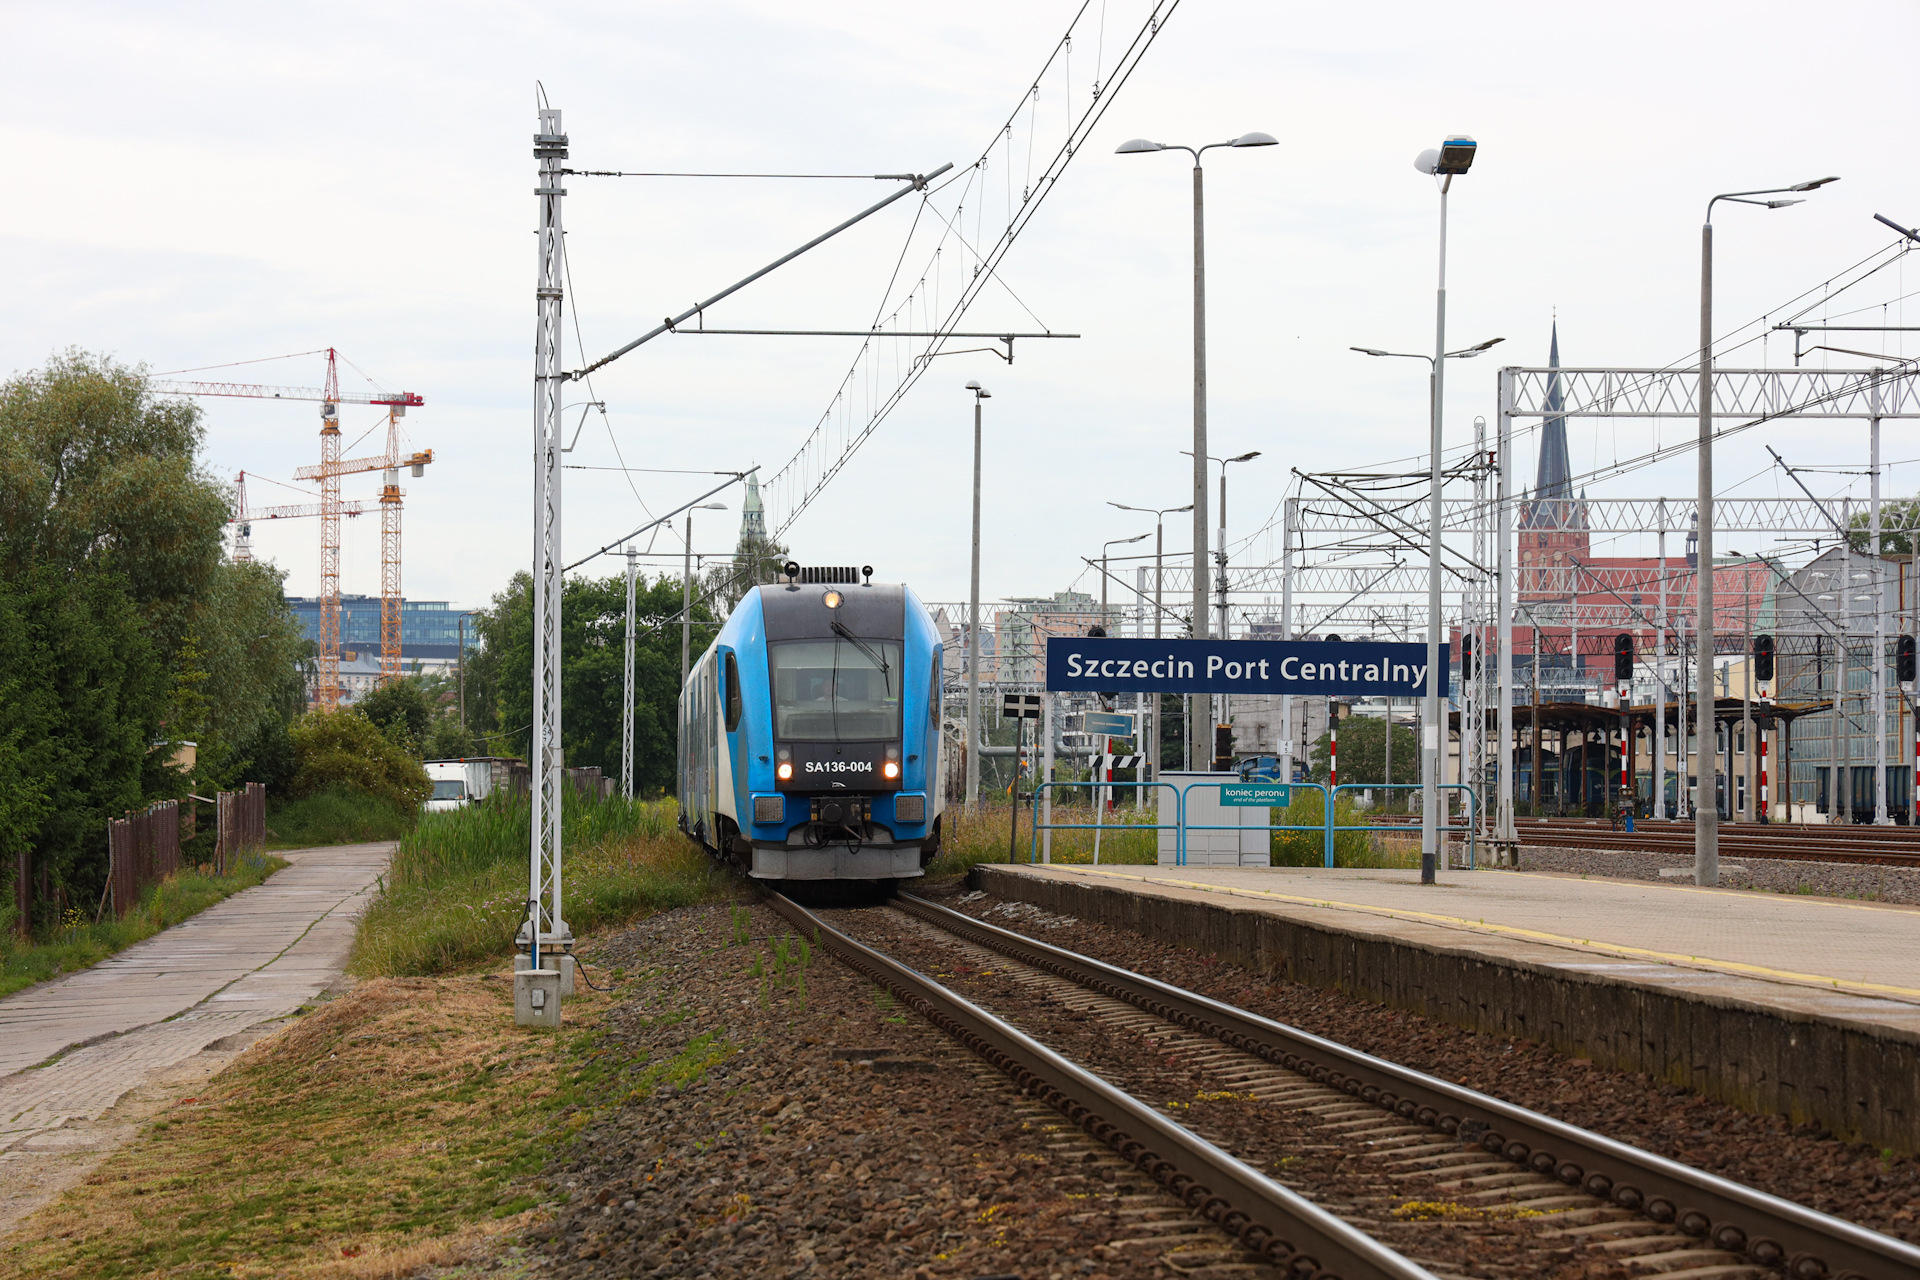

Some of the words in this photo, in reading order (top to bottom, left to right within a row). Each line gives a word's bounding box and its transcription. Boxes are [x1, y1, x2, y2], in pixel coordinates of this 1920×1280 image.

[1067, 653, 1194, 679] Szczecin
[1207, 655, 1270, 680] Port
[1280, 656, 1428, 689] Centralny
[805, 761, 873, 772] SA136-004
[1225, 788, 1253, 797] koniec
[1254, 790, 1285, 798] peronu
